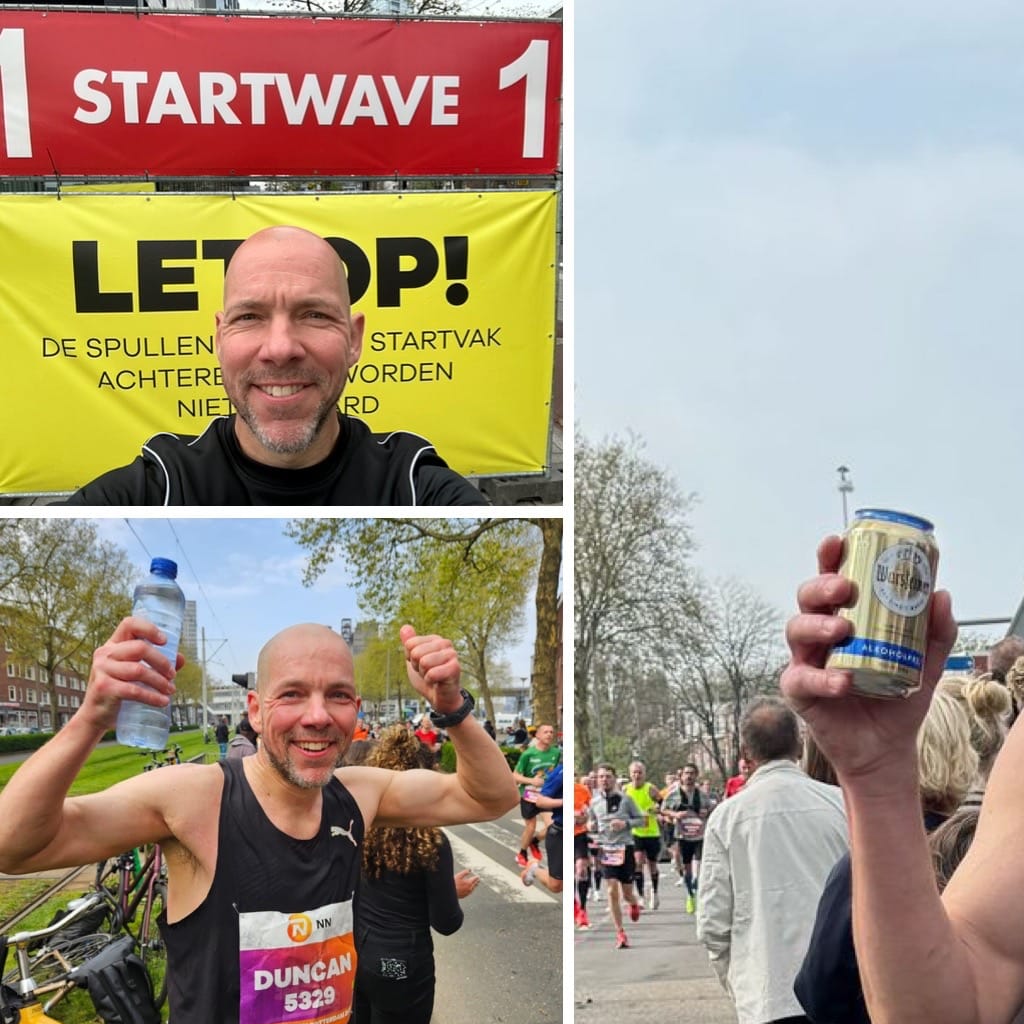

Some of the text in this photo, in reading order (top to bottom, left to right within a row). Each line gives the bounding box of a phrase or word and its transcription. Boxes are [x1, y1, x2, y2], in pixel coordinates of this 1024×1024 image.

[73, 69, 460, 126] STARTWAVE
[499, 39, 549, 159] 1
[42, 327, 502, 359] DE SPULLEN STARTVAK
[98, 367, 225, 390] ACHTER
[316, 917, 332, 929] NN
[254, 952, 352, 991] DUNCAN
[284, 985, 336, 1013] 5329
